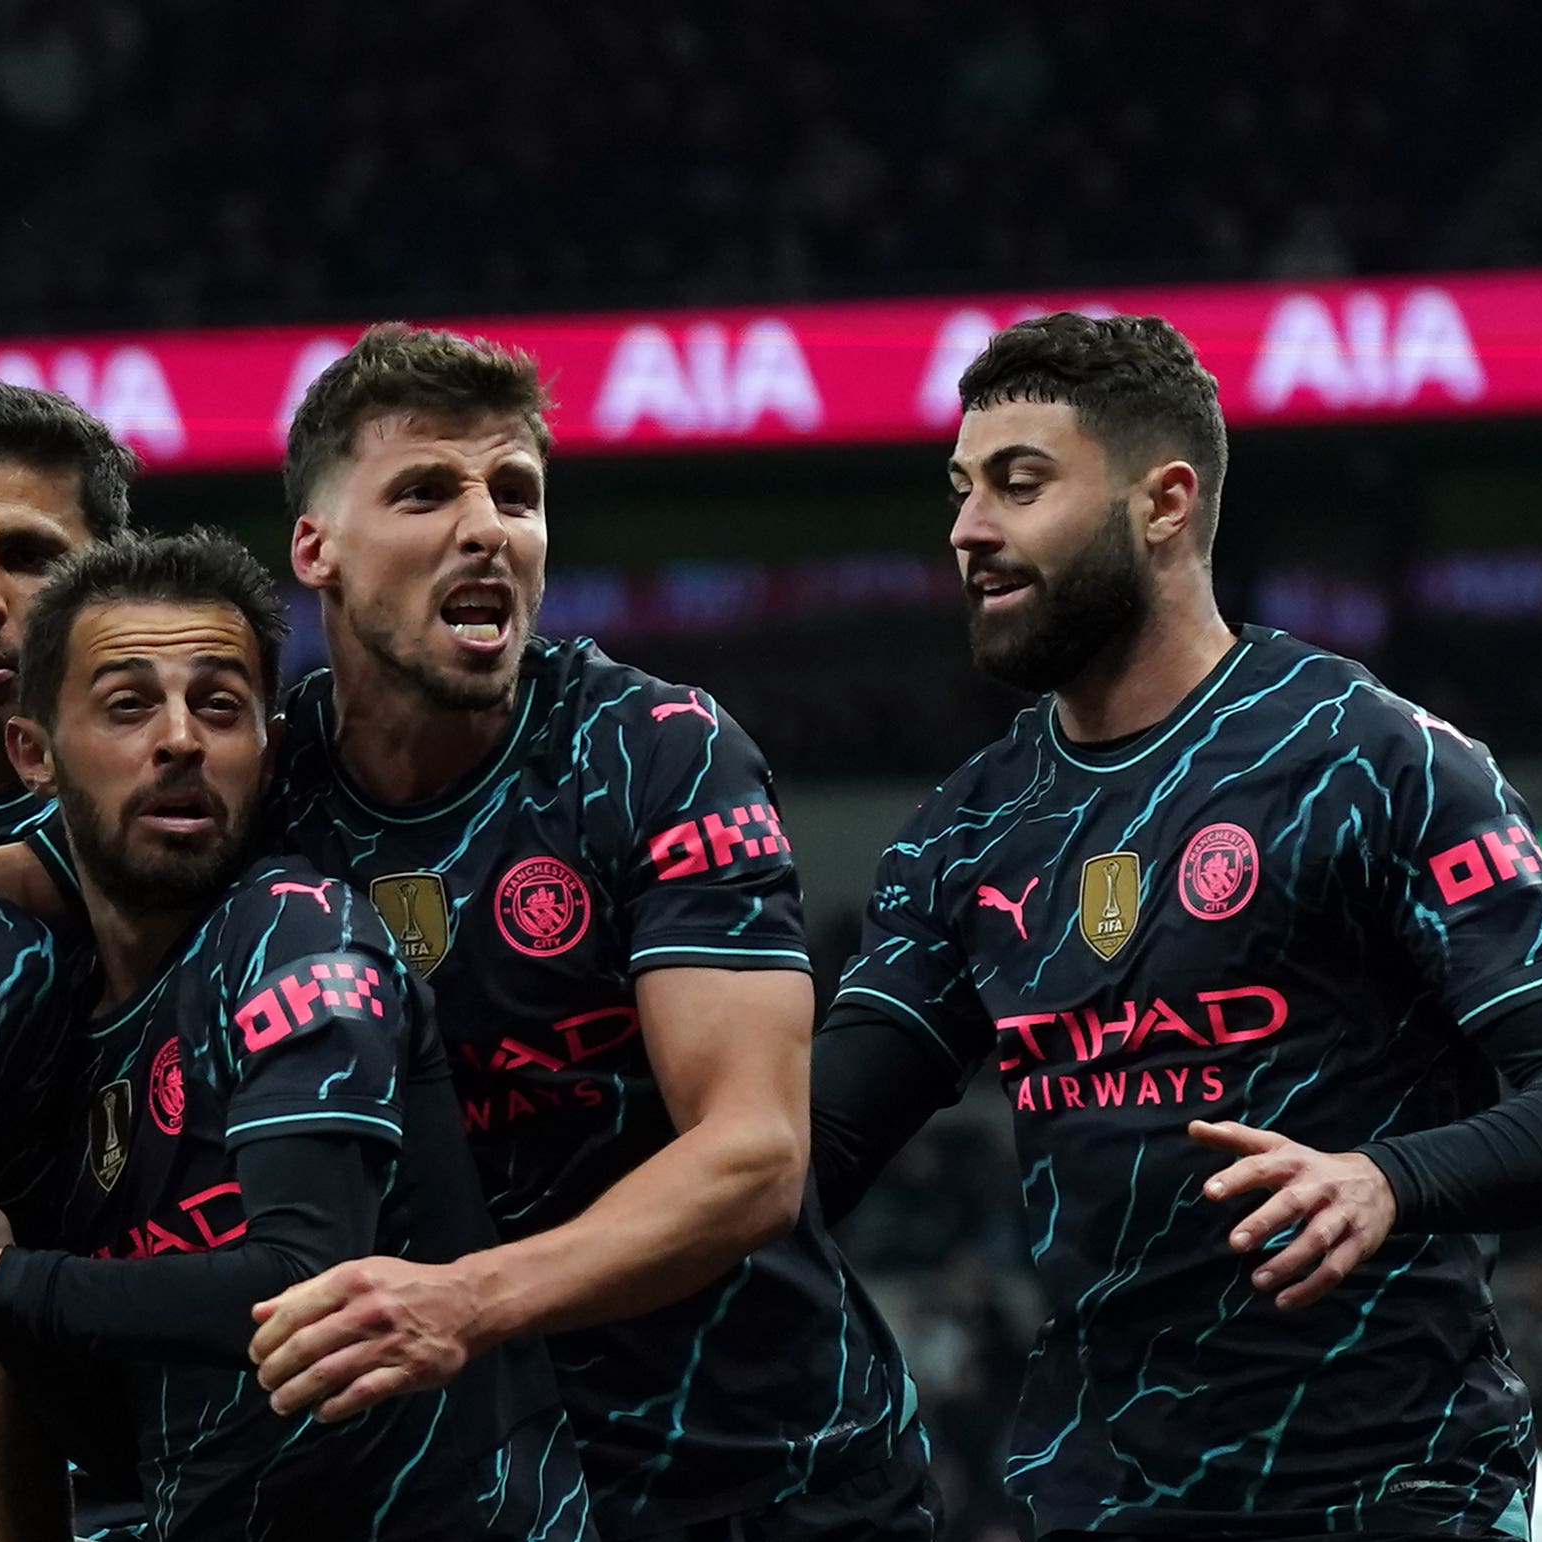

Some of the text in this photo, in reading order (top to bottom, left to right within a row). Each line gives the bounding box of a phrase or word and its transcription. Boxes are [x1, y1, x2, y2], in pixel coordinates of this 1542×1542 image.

[1252, 288, 1485, 410] AIA
[594, 319, 824, 440] AIA
[504, 865, 577, 898] MANCHESTER
[1204, 901, 1229, 912] CITY
[1098, 919, 1122, 933] FIFA
[401, 943, 429, 957] IFA
[532, 937, 562, 949] CITY
[1017, 1066, 1225, 1112] AIRWAYS
